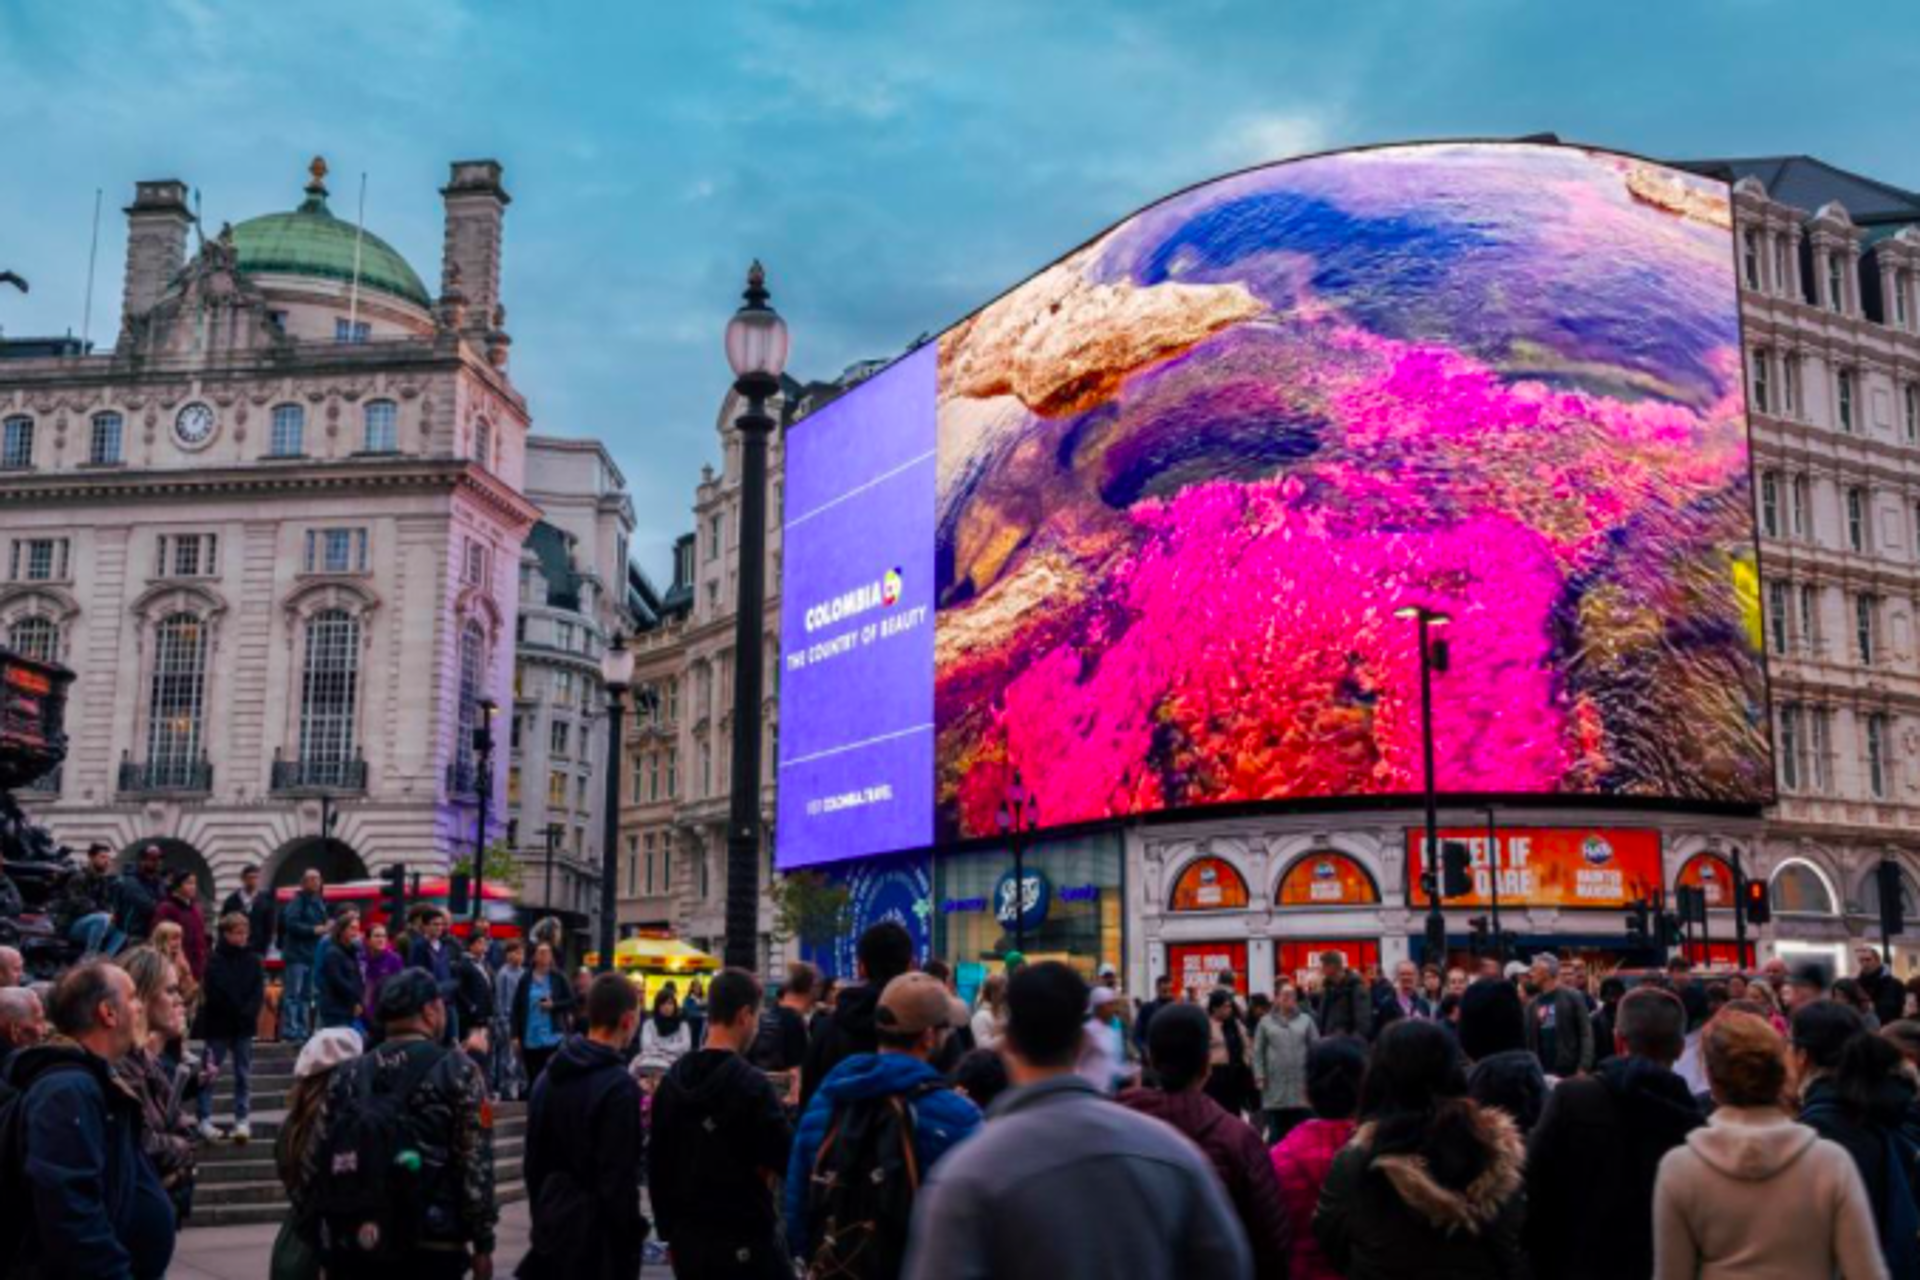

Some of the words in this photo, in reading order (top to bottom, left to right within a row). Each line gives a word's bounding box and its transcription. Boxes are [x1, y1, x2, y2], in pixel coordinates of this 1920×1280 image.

[805, 582, 881, 632] COLOMBIA
[787, 650, 805, 671] THE
[808, 631, 858, 664] COUNTRY
[861, 624, 877, 645] OF
[881, 605, 927, 639] BEAUTY
[1509, 837, 1531, 867] IF
